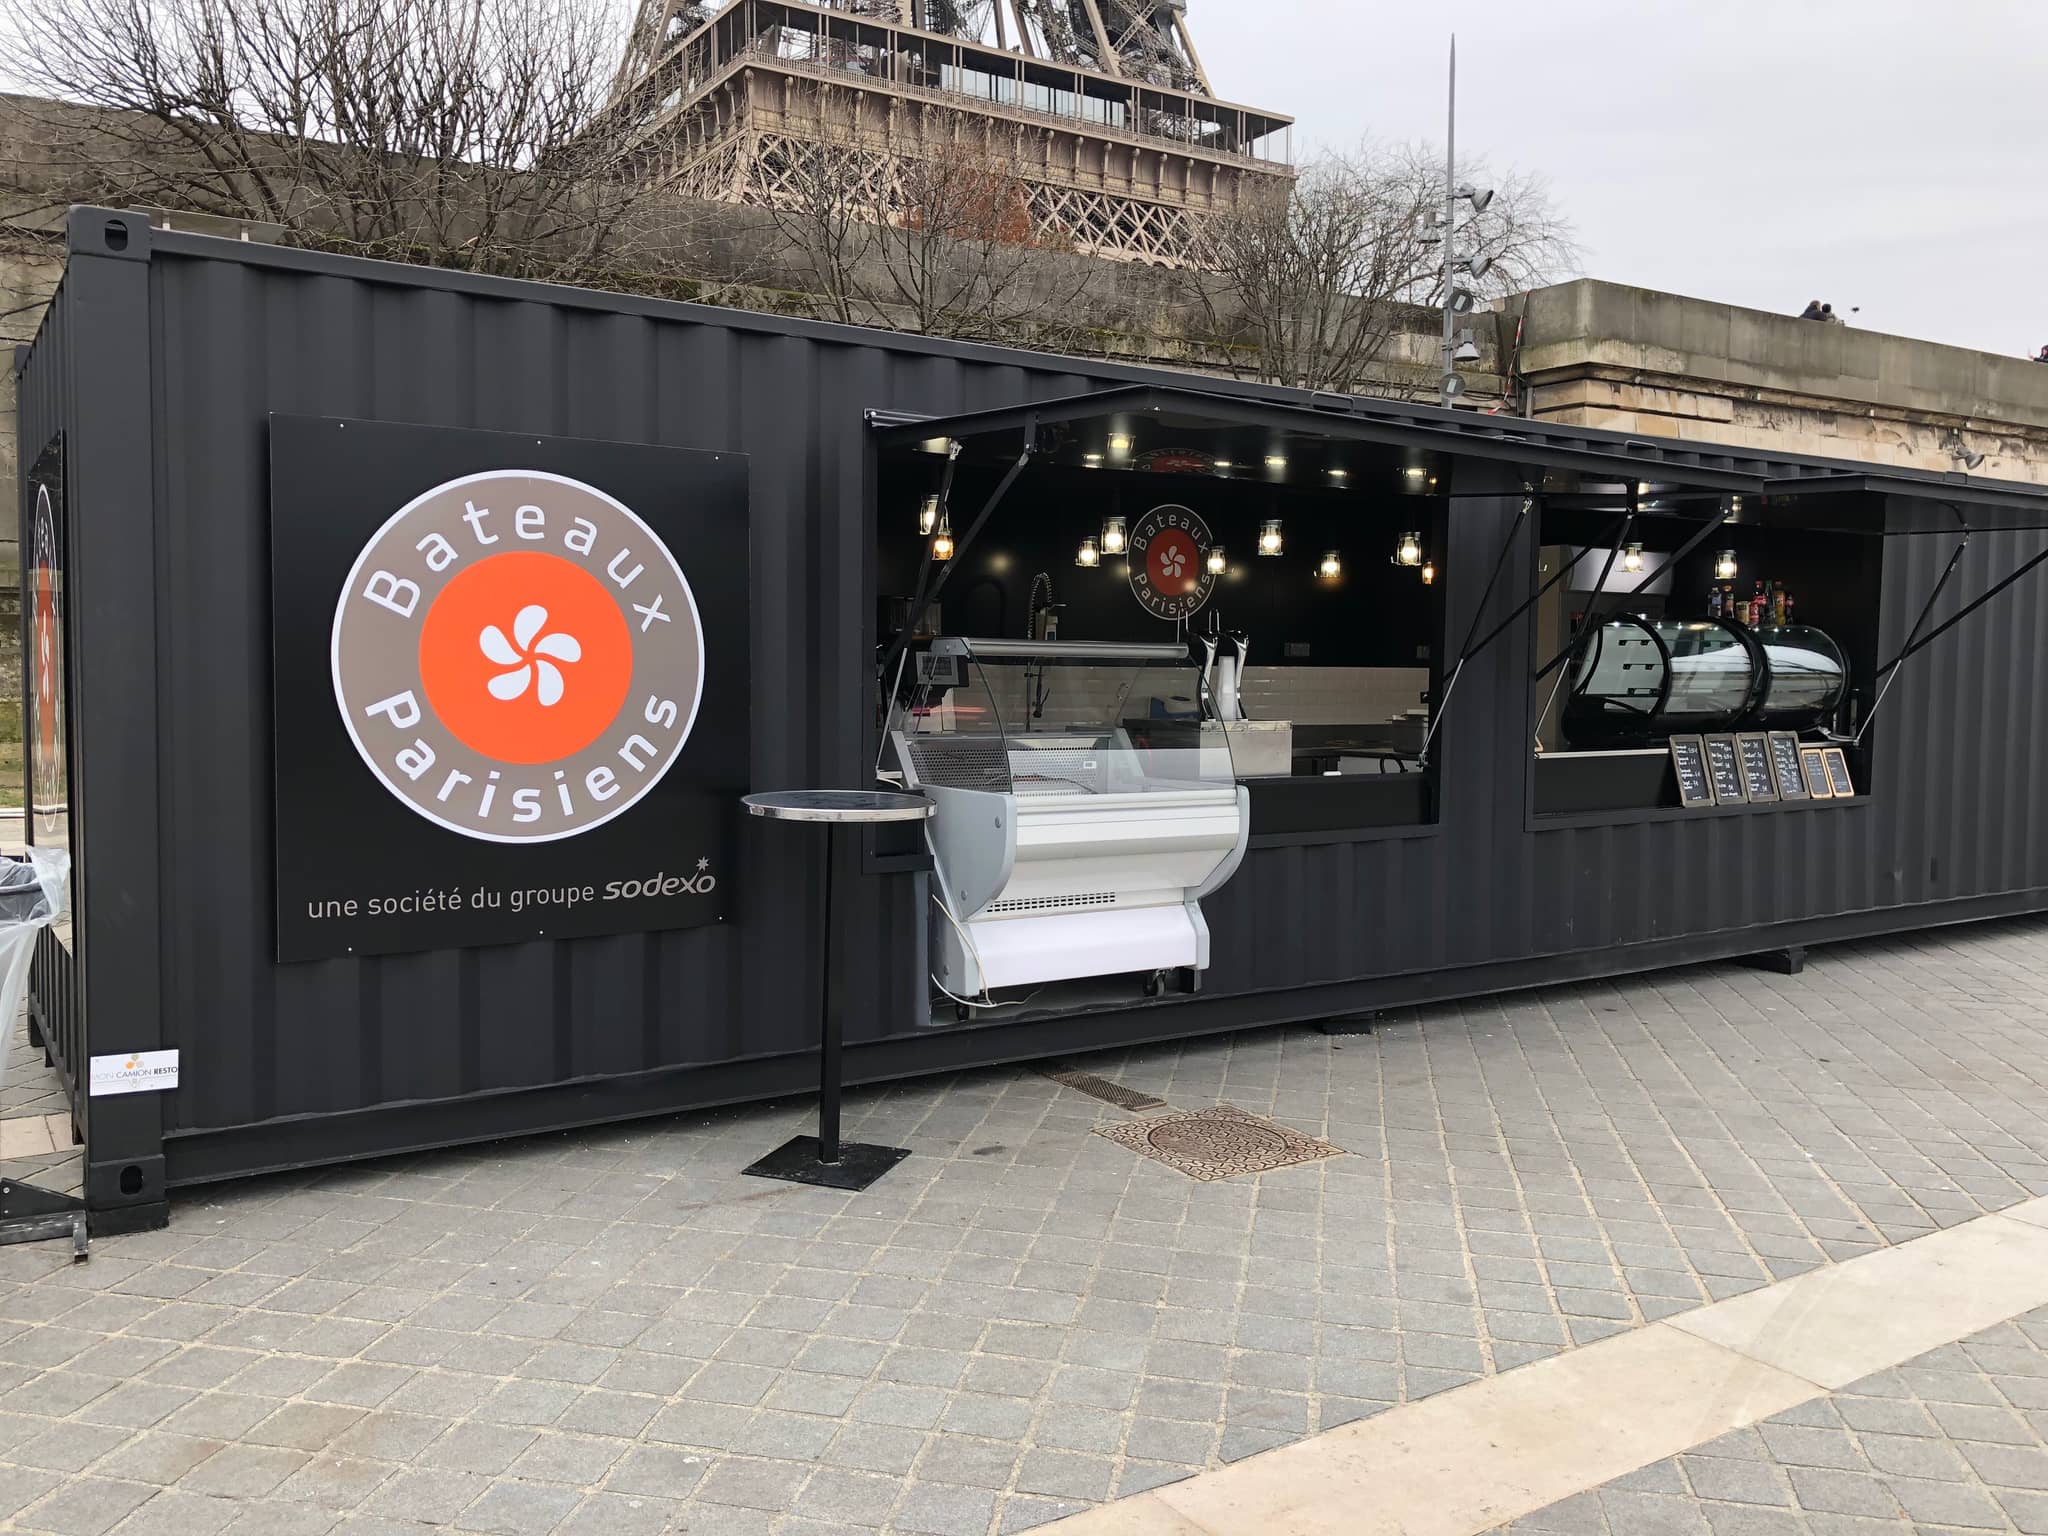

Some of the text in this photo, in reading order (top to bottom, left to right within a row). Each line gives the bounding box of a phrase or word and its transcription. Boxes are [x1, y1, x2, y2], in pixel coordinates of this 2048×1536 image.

[1133, 514, 1209, 553] Bateaux
[363, 500, 671, 632] Bateaux
[1135, 573, 1211, 614] Parisiens
[365, 690, 677, 823] Parisiens
[307, 868, 716, 919] une société du groupe sodexo
[116, 1069, 152, 1079] CAMION
[153, 1066, 178, 1075] RESTO
